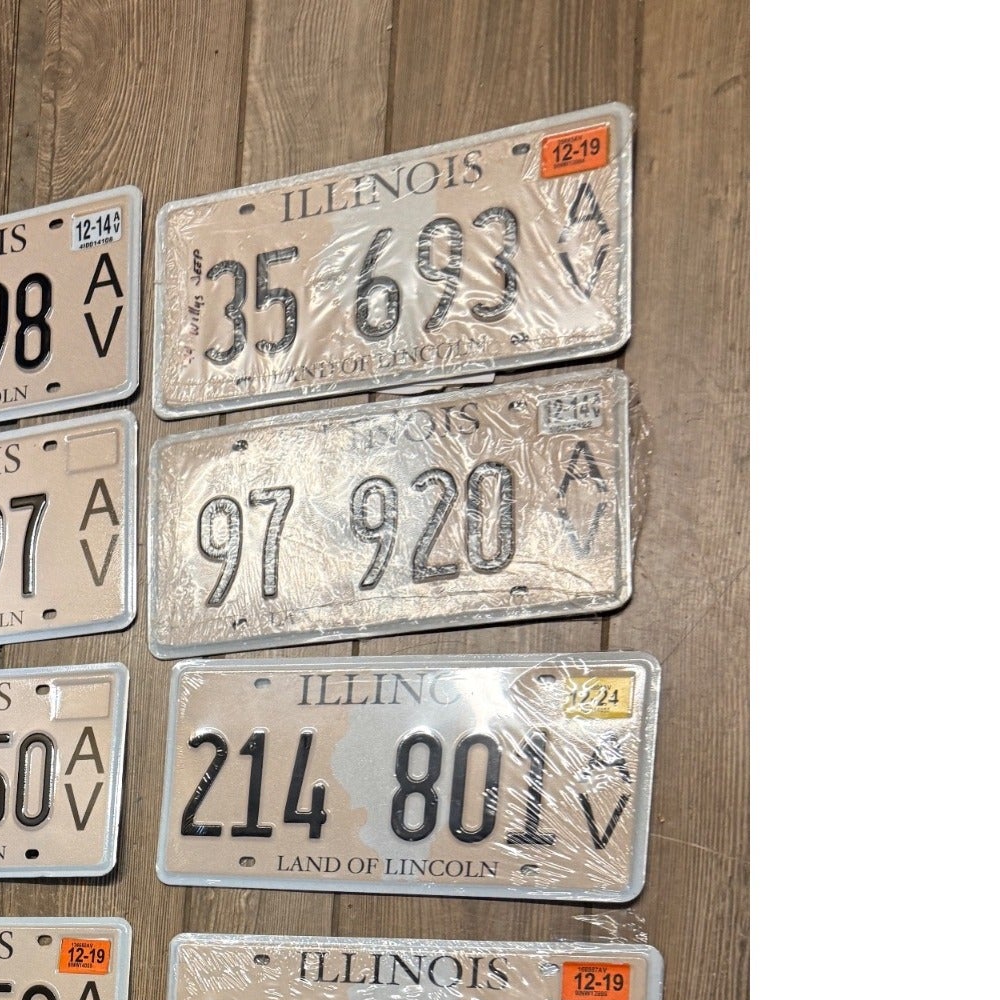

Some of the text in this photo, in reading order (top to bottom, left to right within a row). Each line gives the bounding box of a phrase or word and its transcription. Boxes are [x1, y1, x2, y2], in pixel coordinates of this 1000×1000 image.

[552, 138, 601, 163] 12-19
[280, 150, 484, 222] ILLINOIS
[76, 214, 111, 241] 12-14
[191, 249, 203, 286] JEEP
[205, 206, 519, 366] 35 693
[273, 361, 334, 381] AND
[341, 355, 371, 375] OF
[199, 461, 517, 607] 97 920
[180, 726, 556, 847] 214 801
[278, 855, 499, 879] LAND OF LINCOLN
[68, 947, 105, 963] 12-19
[300, 951, 509, 991] ILLINOIS
[574, 973, 624, 991] 12-19
